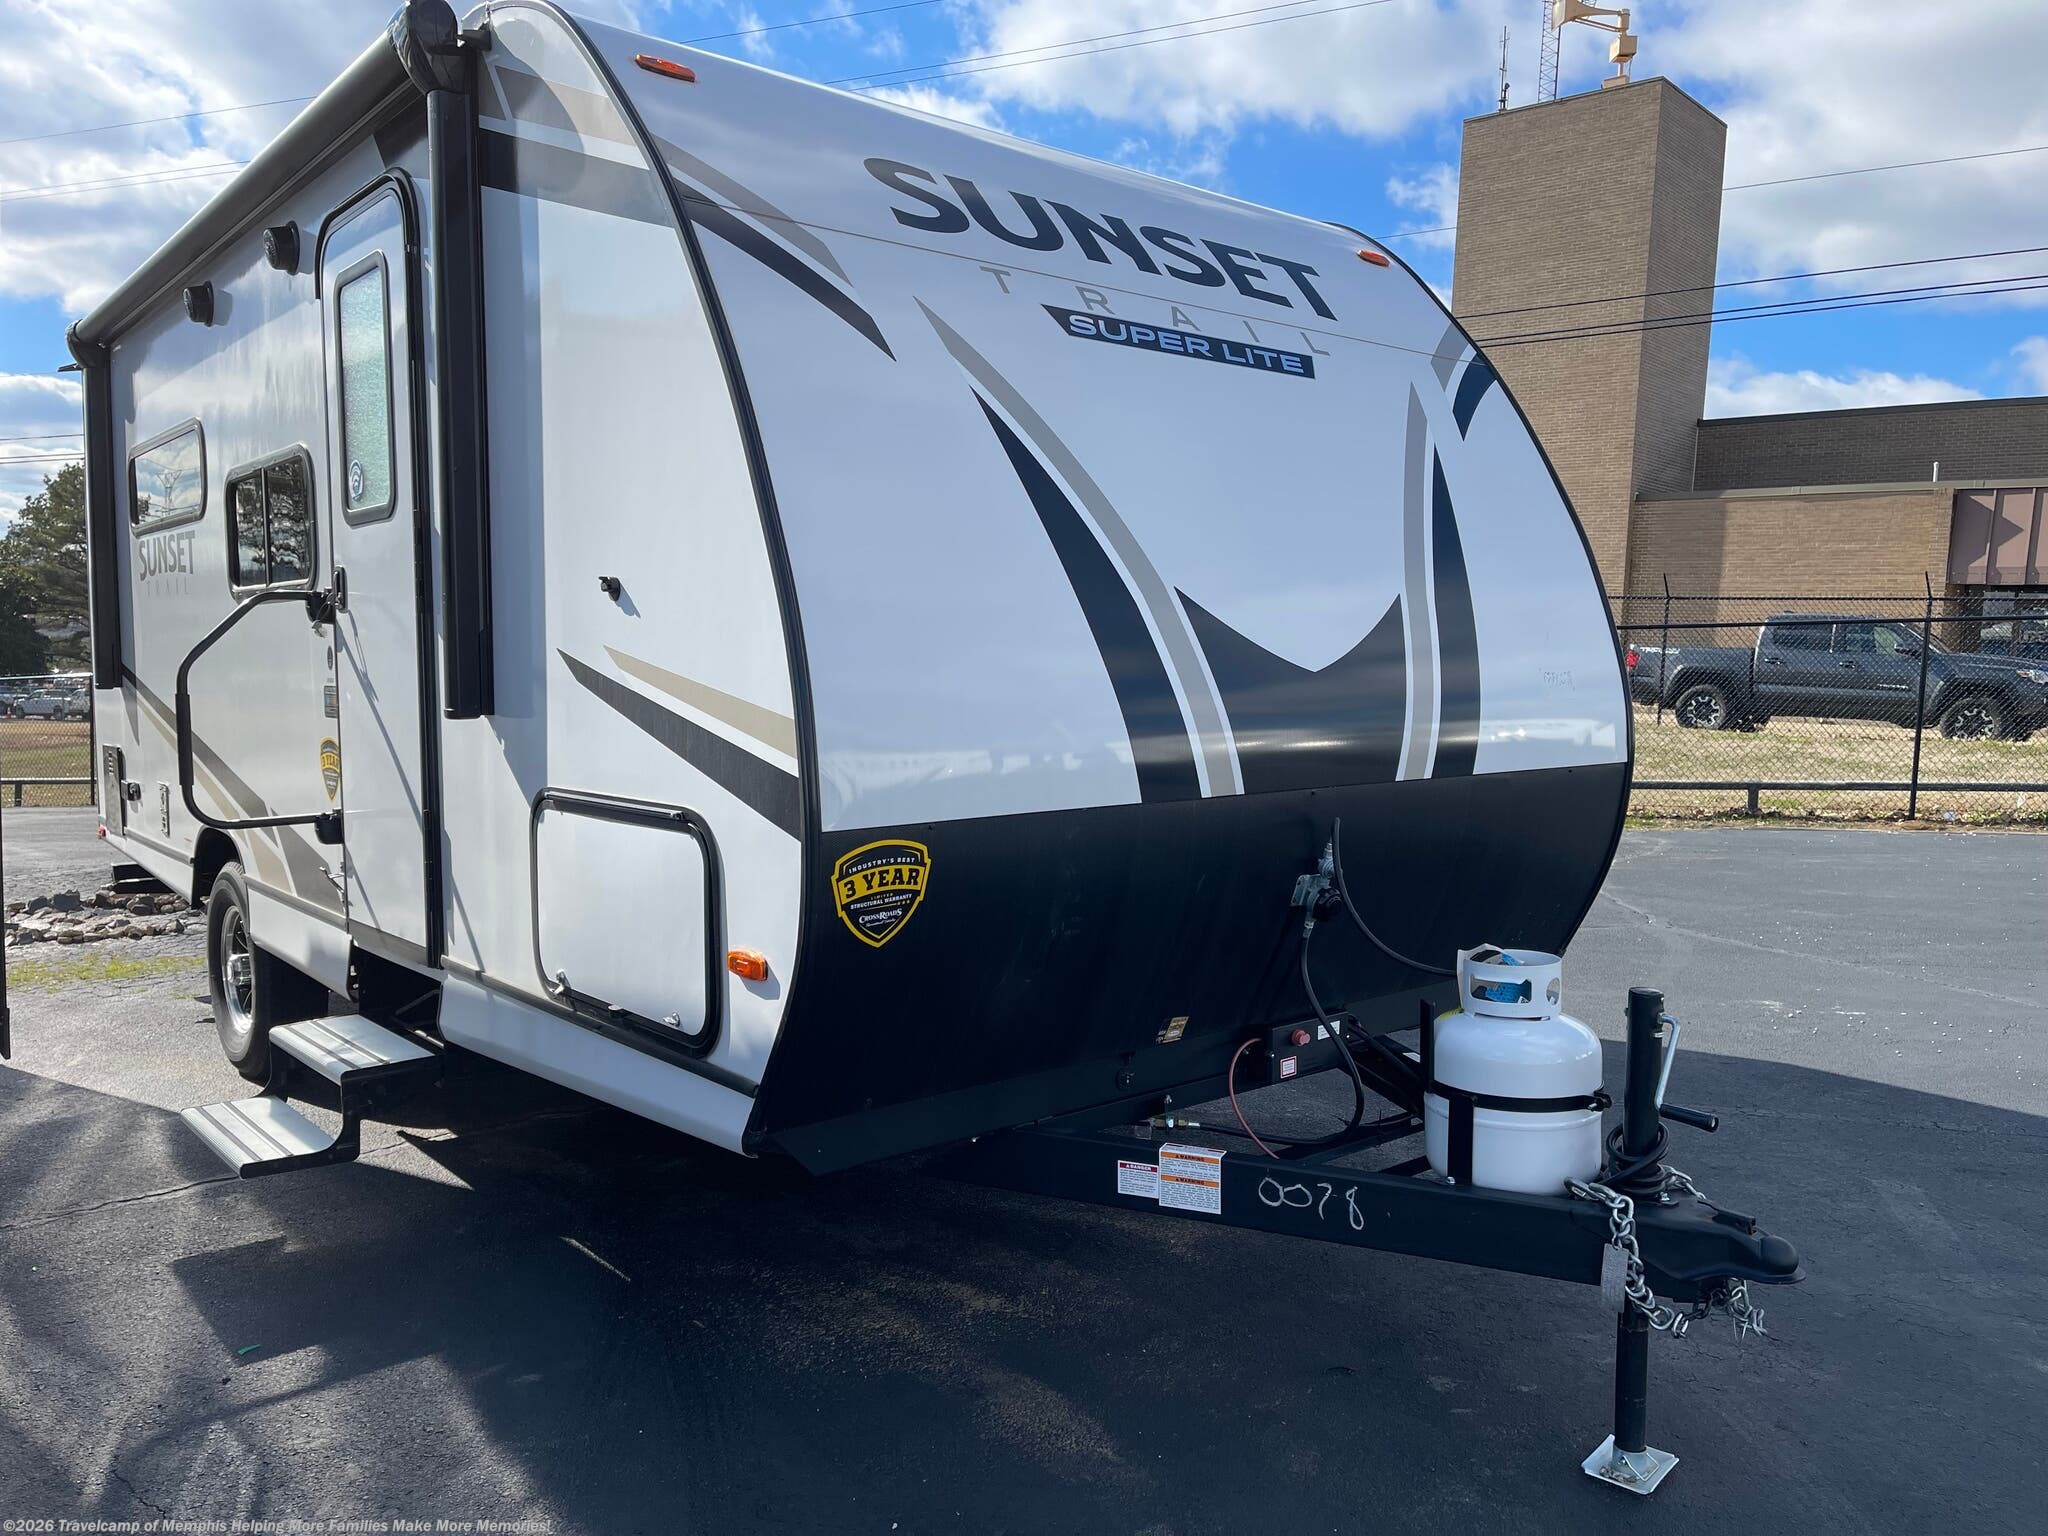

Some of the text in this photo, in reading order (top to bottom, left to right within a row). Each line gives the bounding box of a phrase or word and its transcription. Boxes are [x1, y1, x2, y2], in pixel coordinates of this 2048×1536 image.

[863, 157, 1338, 321] SUNSET
[979, 265, 1330, 356] TRAIL
[1069, 314, 1304, 373] SUPER LITE
[139, 530, 195, 581] SUNSET
[843, 868, 920, 899] 3 YEAR
[849, 857, 894, 874] INDUSTRY'S
[850, 898, 883, 910] STRUCTURAL
